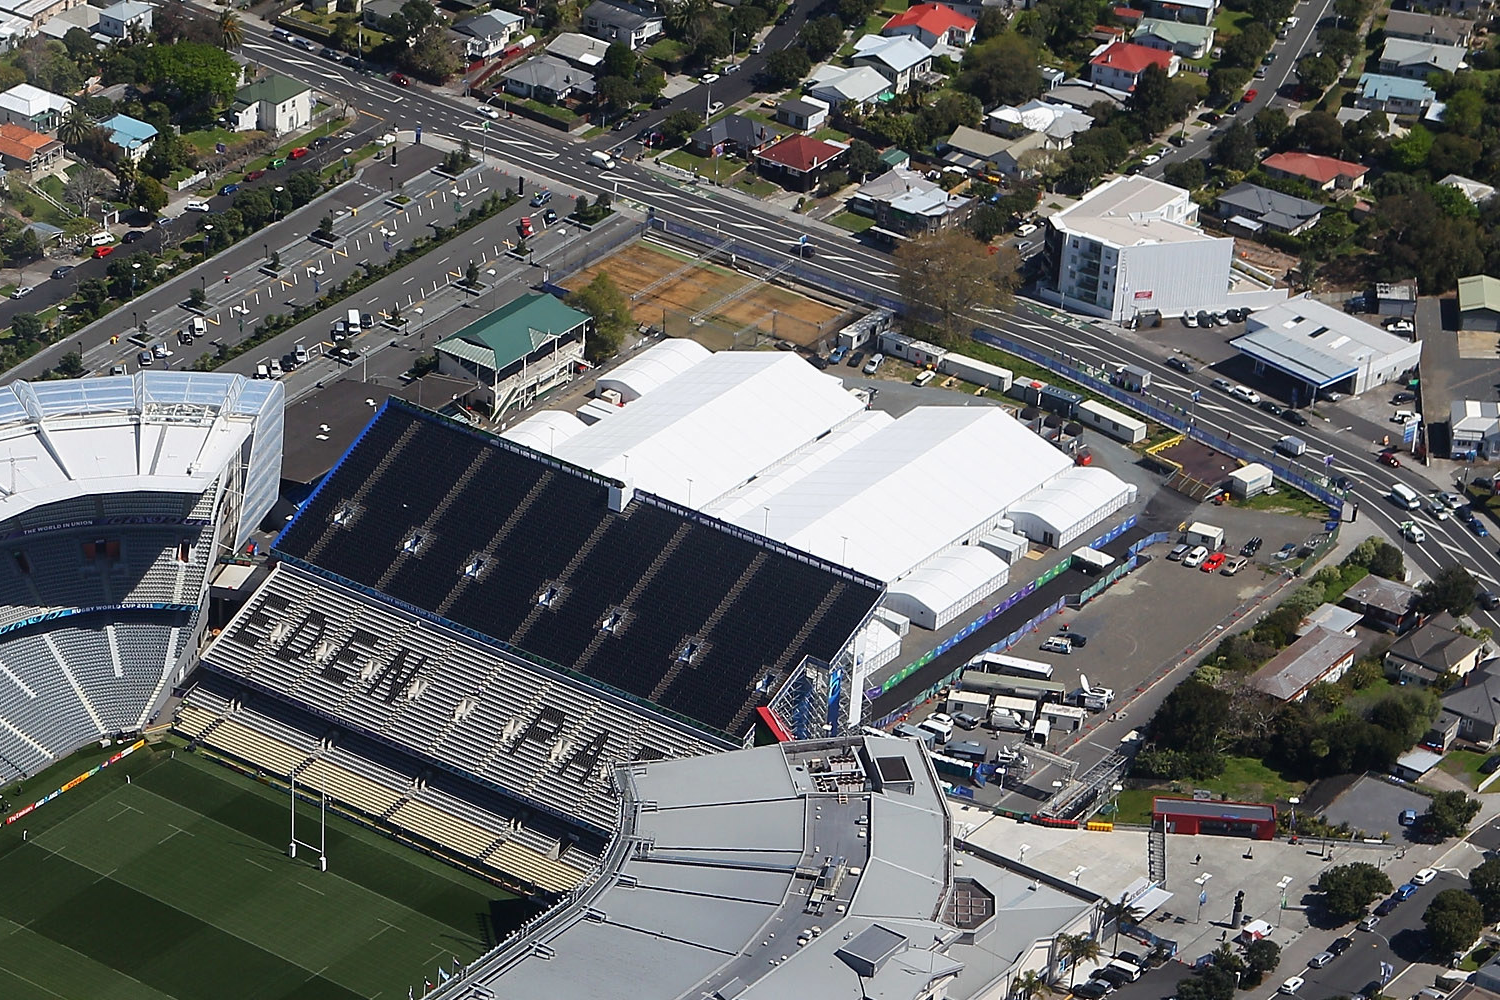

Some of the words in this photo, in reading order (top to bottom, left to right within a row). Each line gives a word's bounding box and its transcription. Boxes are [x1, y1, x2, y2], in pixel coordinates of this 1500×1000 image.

[72, 606, 96, 615] RUGBY
[394, 601, 414, 611] WORLD
[232, 592, 428, 705] EDEN
